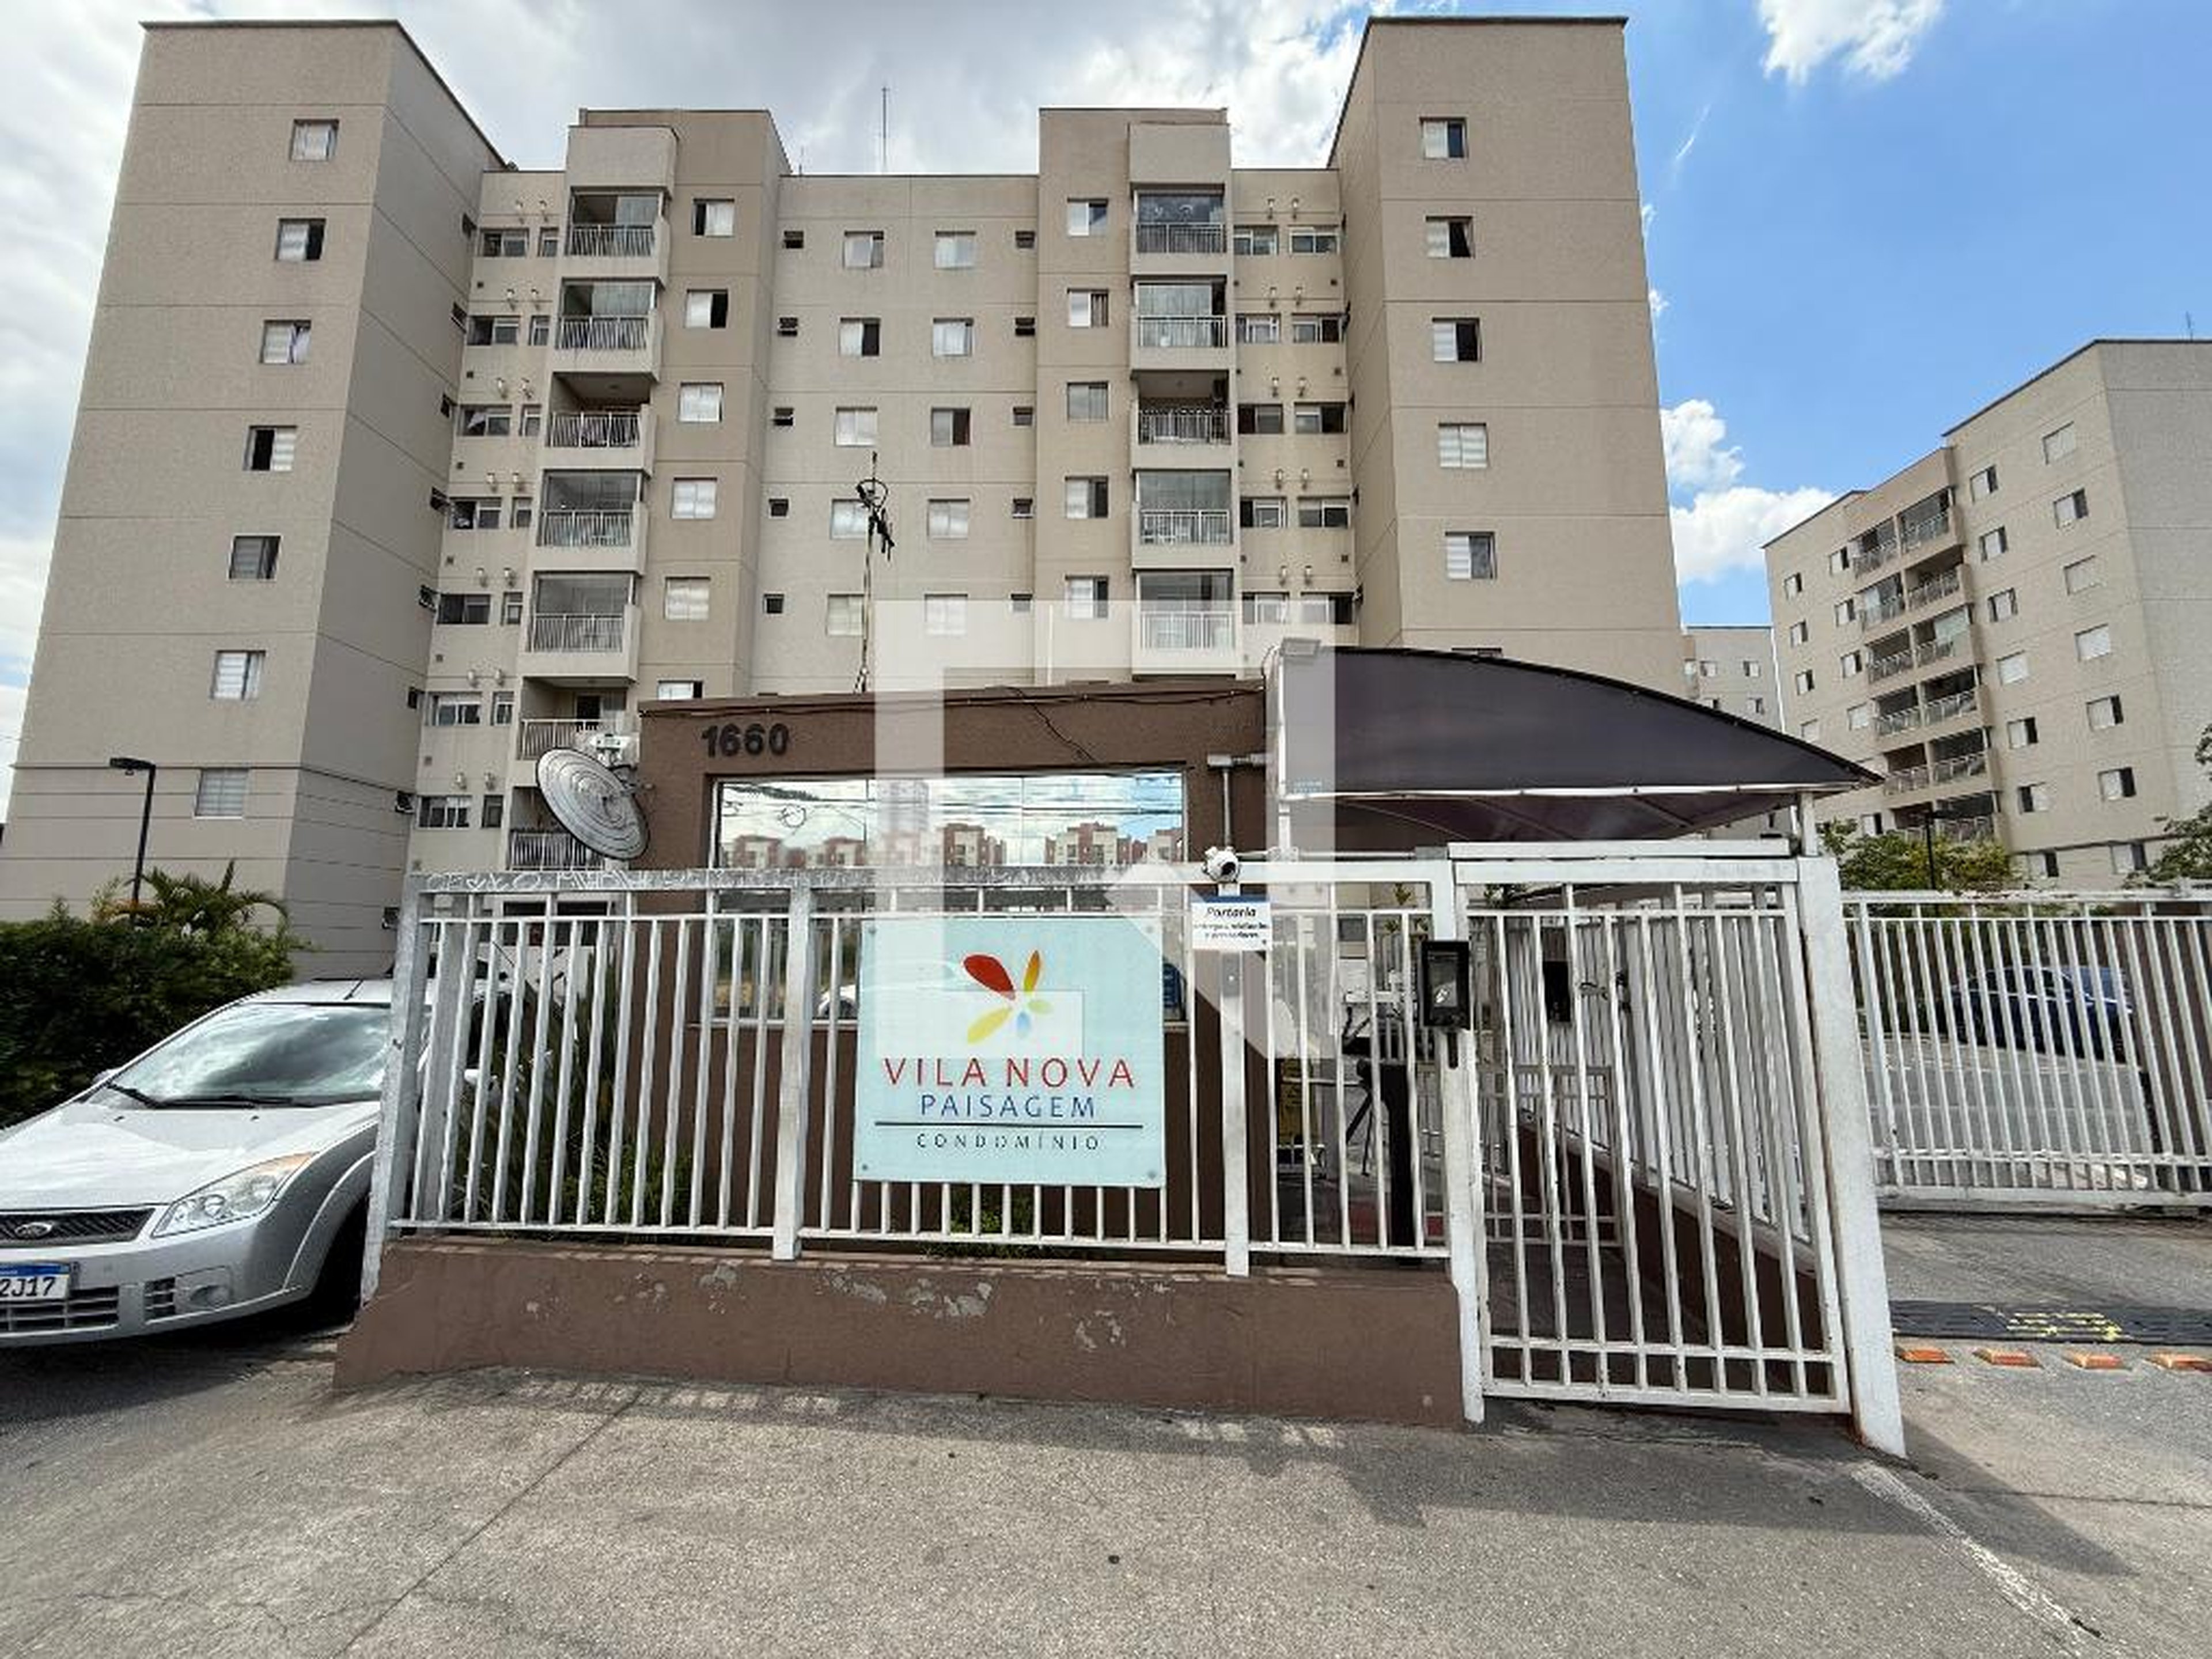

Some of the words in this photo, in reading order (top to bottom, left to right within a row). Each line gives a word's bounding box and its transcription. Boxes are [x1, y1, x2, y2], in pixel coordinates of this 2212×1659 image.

[702, 723, 789, 757] 1660
[885, 1058, 986, 1086] VILA
[1006, 1058, 1134, 1088] NOVA
[921, 1095, 1094, 1118] PAISAGEM
[917, 1131, 1098, 1150] CONDOMÍNIO
